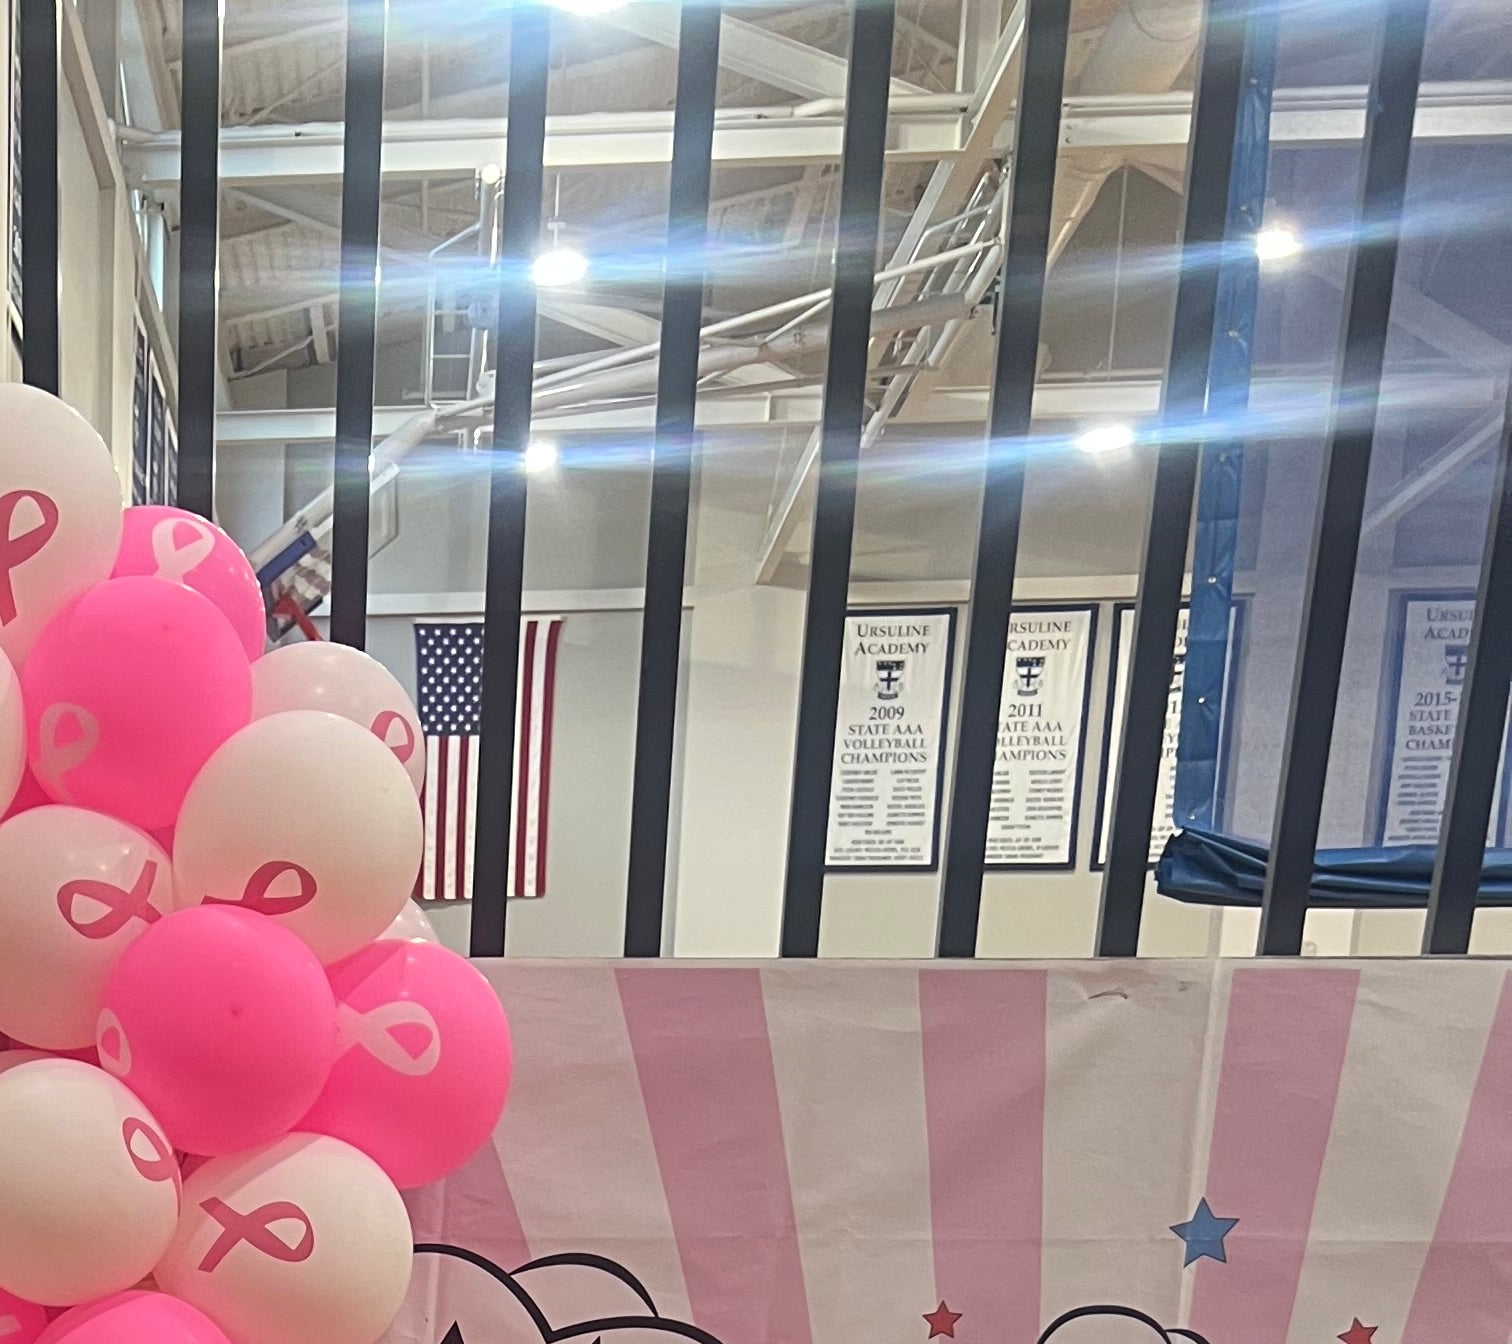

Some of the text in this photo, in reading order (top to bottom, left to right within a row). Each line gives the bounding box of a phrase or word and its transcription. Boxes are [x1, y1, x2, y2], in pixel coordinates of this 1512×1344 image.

[857, 623, 931, 638] URSULINE
[1009, 621, 1072, 634] RSULINE
[1424, 626, 1469, 640] ACAD
[854, 641, 929, 656] ACADEMY
[1008, 639, 1070, 651] CADEMY
[1414, 692, 1458, 707] 2015-
[869, 706, 905, 720] 2009
[1007, 703, 1043, 718] 2011
[848, 724, 924, 736] STATE AAA
[1001, 721, 1063, 733] ATE AAA
[843, 738, 927, 750] VOLLEYBALL
[997, 735, 1067, 747] LLEYBALL
[840, 752, 927, 765] CHAMPIONS
[996, 749, 1067, 762] AMPIONS
